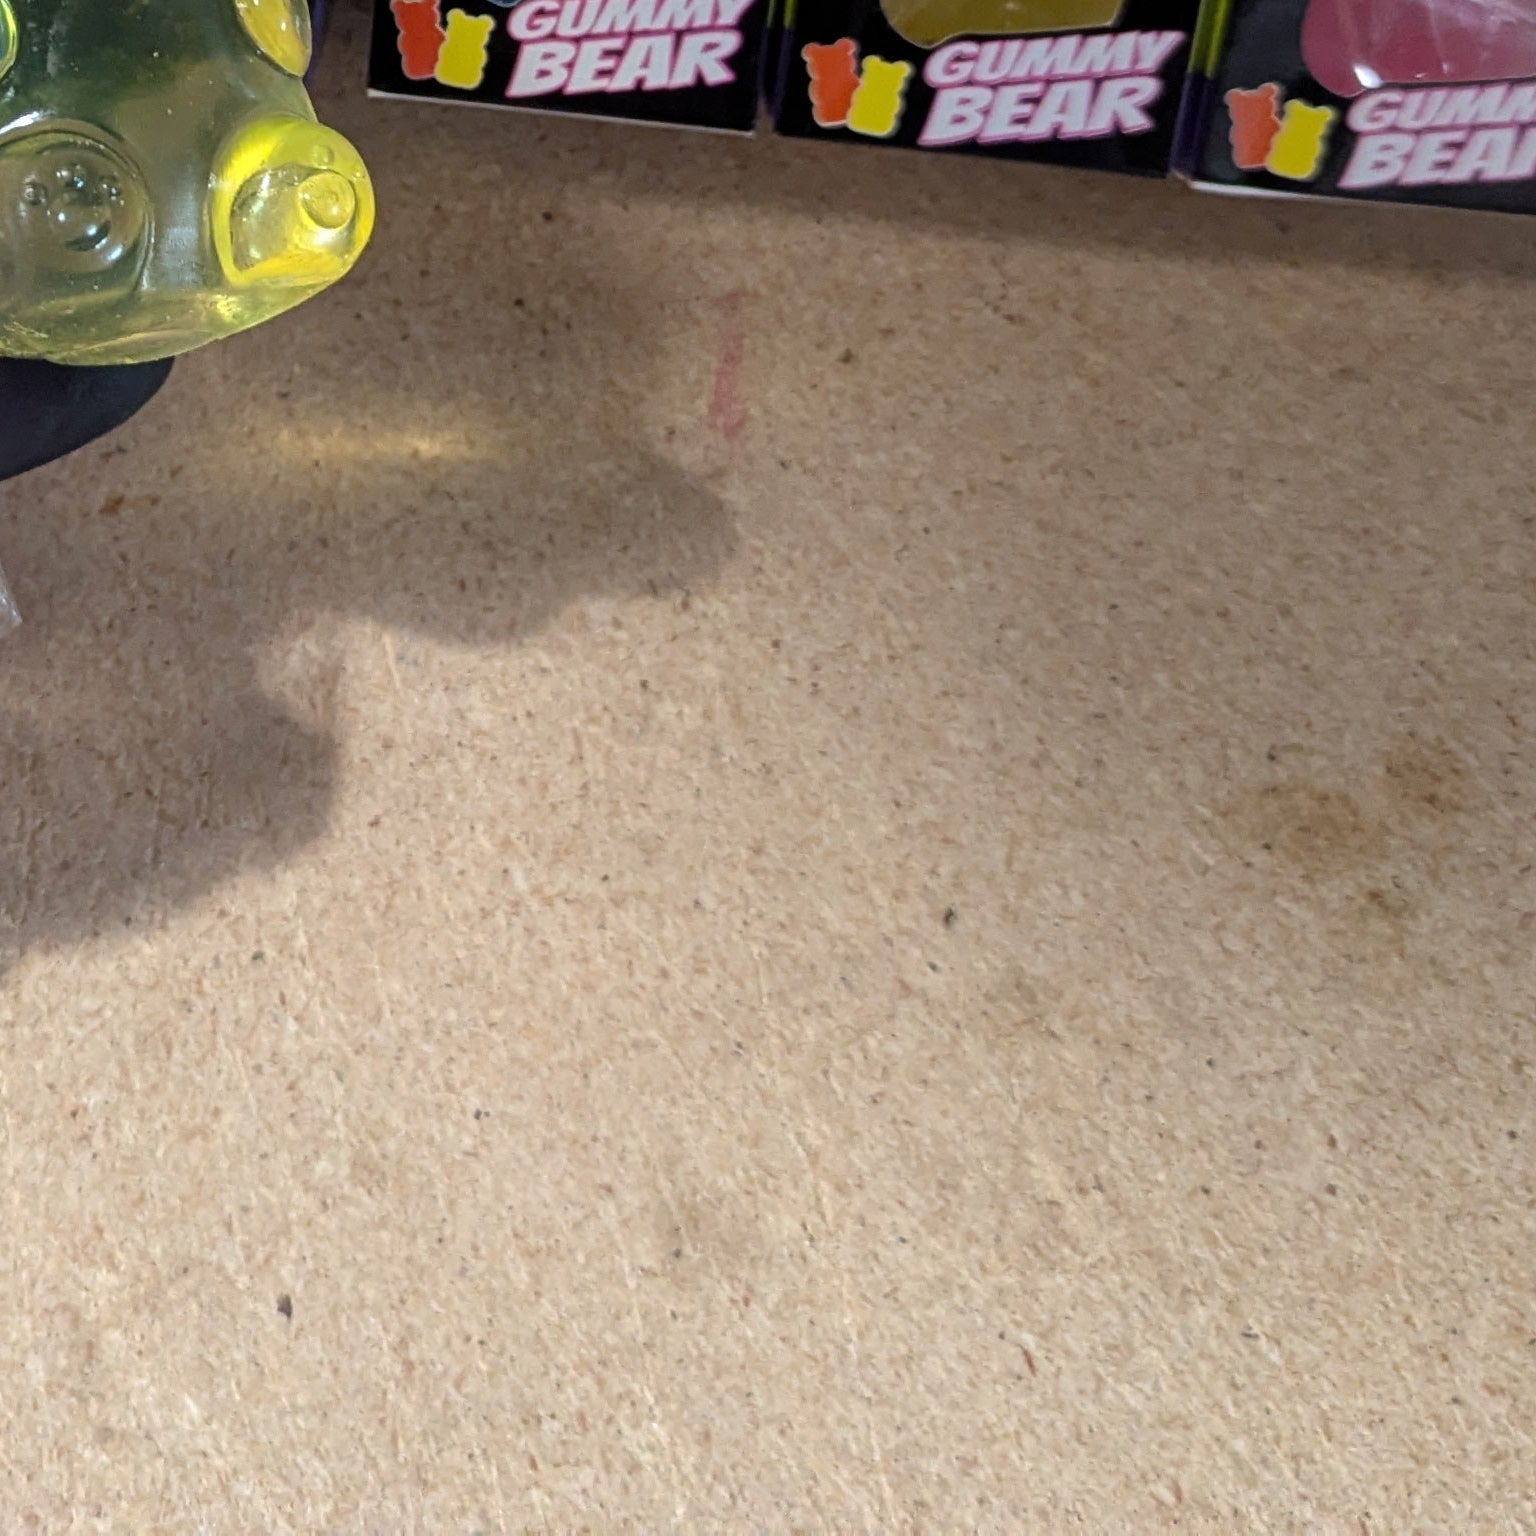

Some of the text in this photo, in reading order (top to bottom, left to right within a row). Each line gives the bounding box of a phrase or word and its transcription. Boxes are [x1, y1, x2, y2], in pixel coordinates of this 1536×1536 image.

[505, 29, 745, 99] BEAR
[922, 29, 1187, 89] GUMMY
[917, 75, 1165, 146] BEAR
[1346, 83, 1536, 133] GUMM
